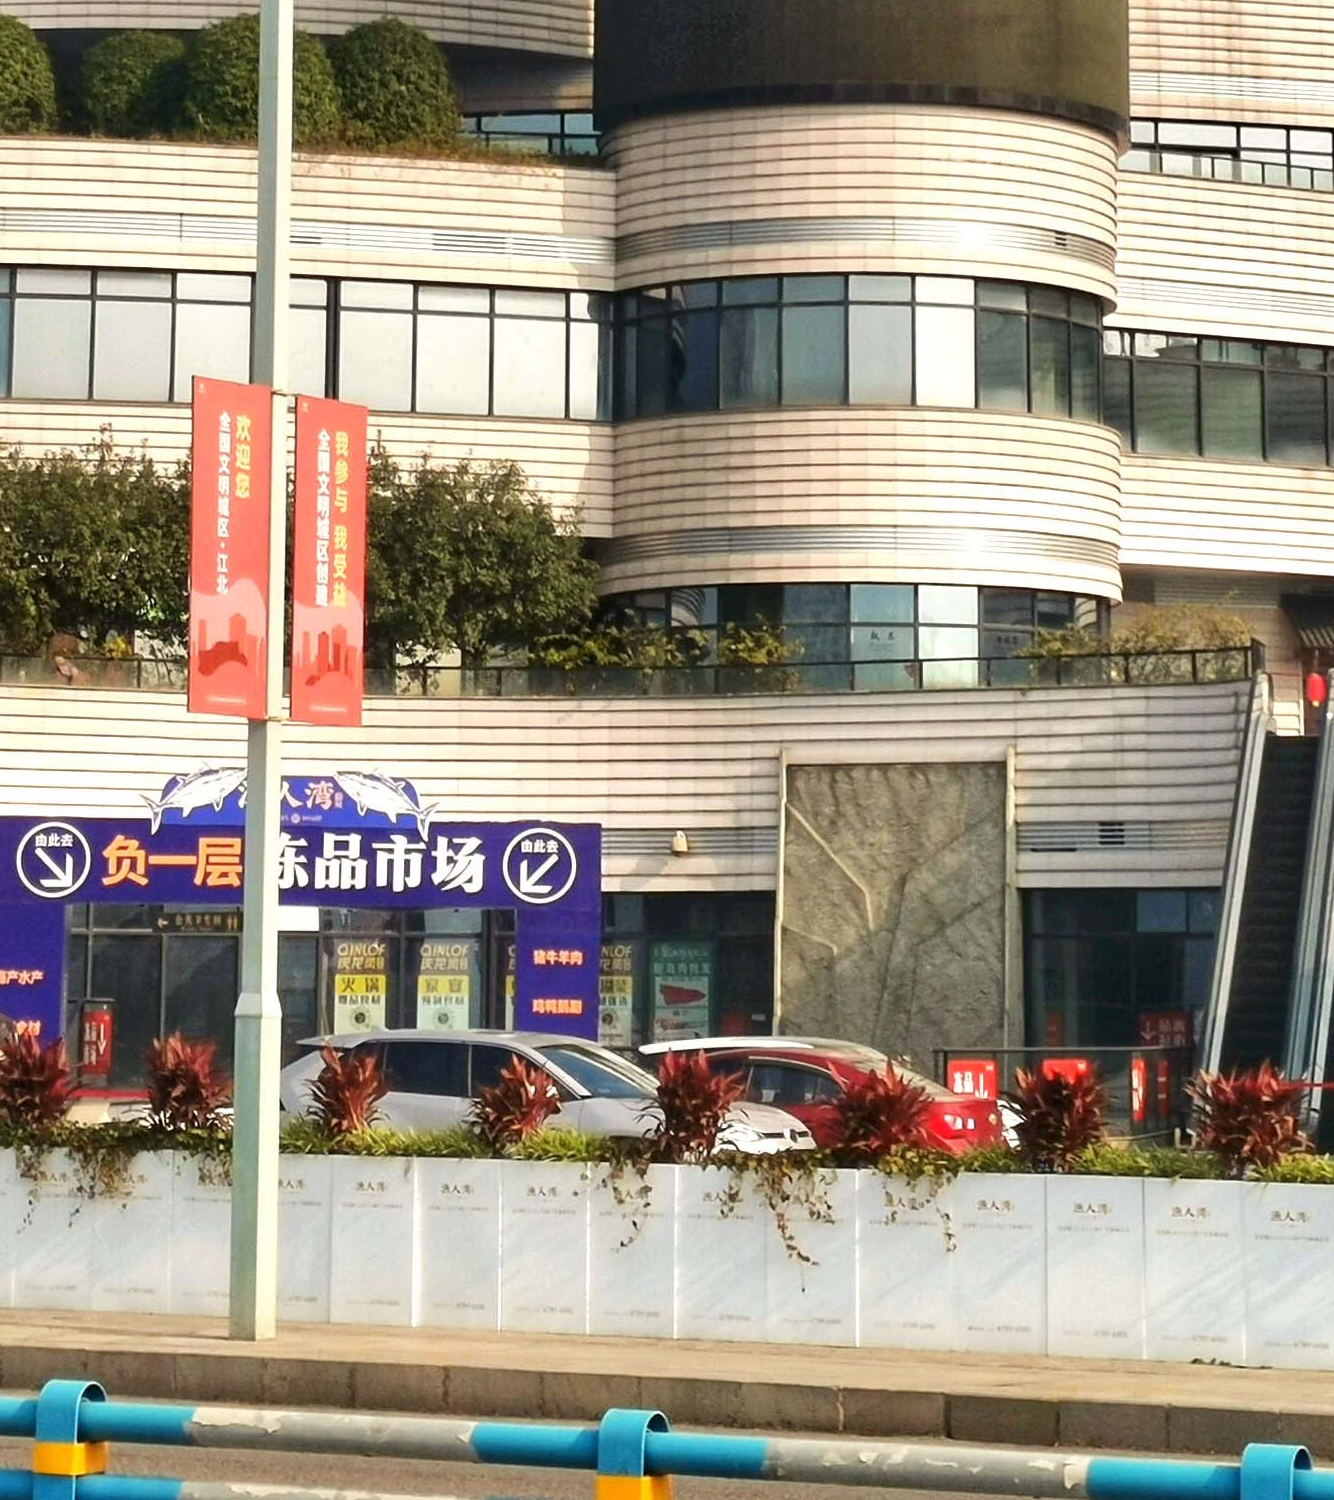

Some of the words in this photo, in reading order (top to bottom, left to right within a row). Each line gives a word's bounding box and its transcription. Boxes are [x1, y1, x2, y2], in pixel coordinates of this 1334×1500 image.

[234, 413, 251, 499] 欢迎您
[334, 430, 350, 514] 我参与
[35, 833, 73, 848] 由此去
[521, 839, 559, 854] 由此去
